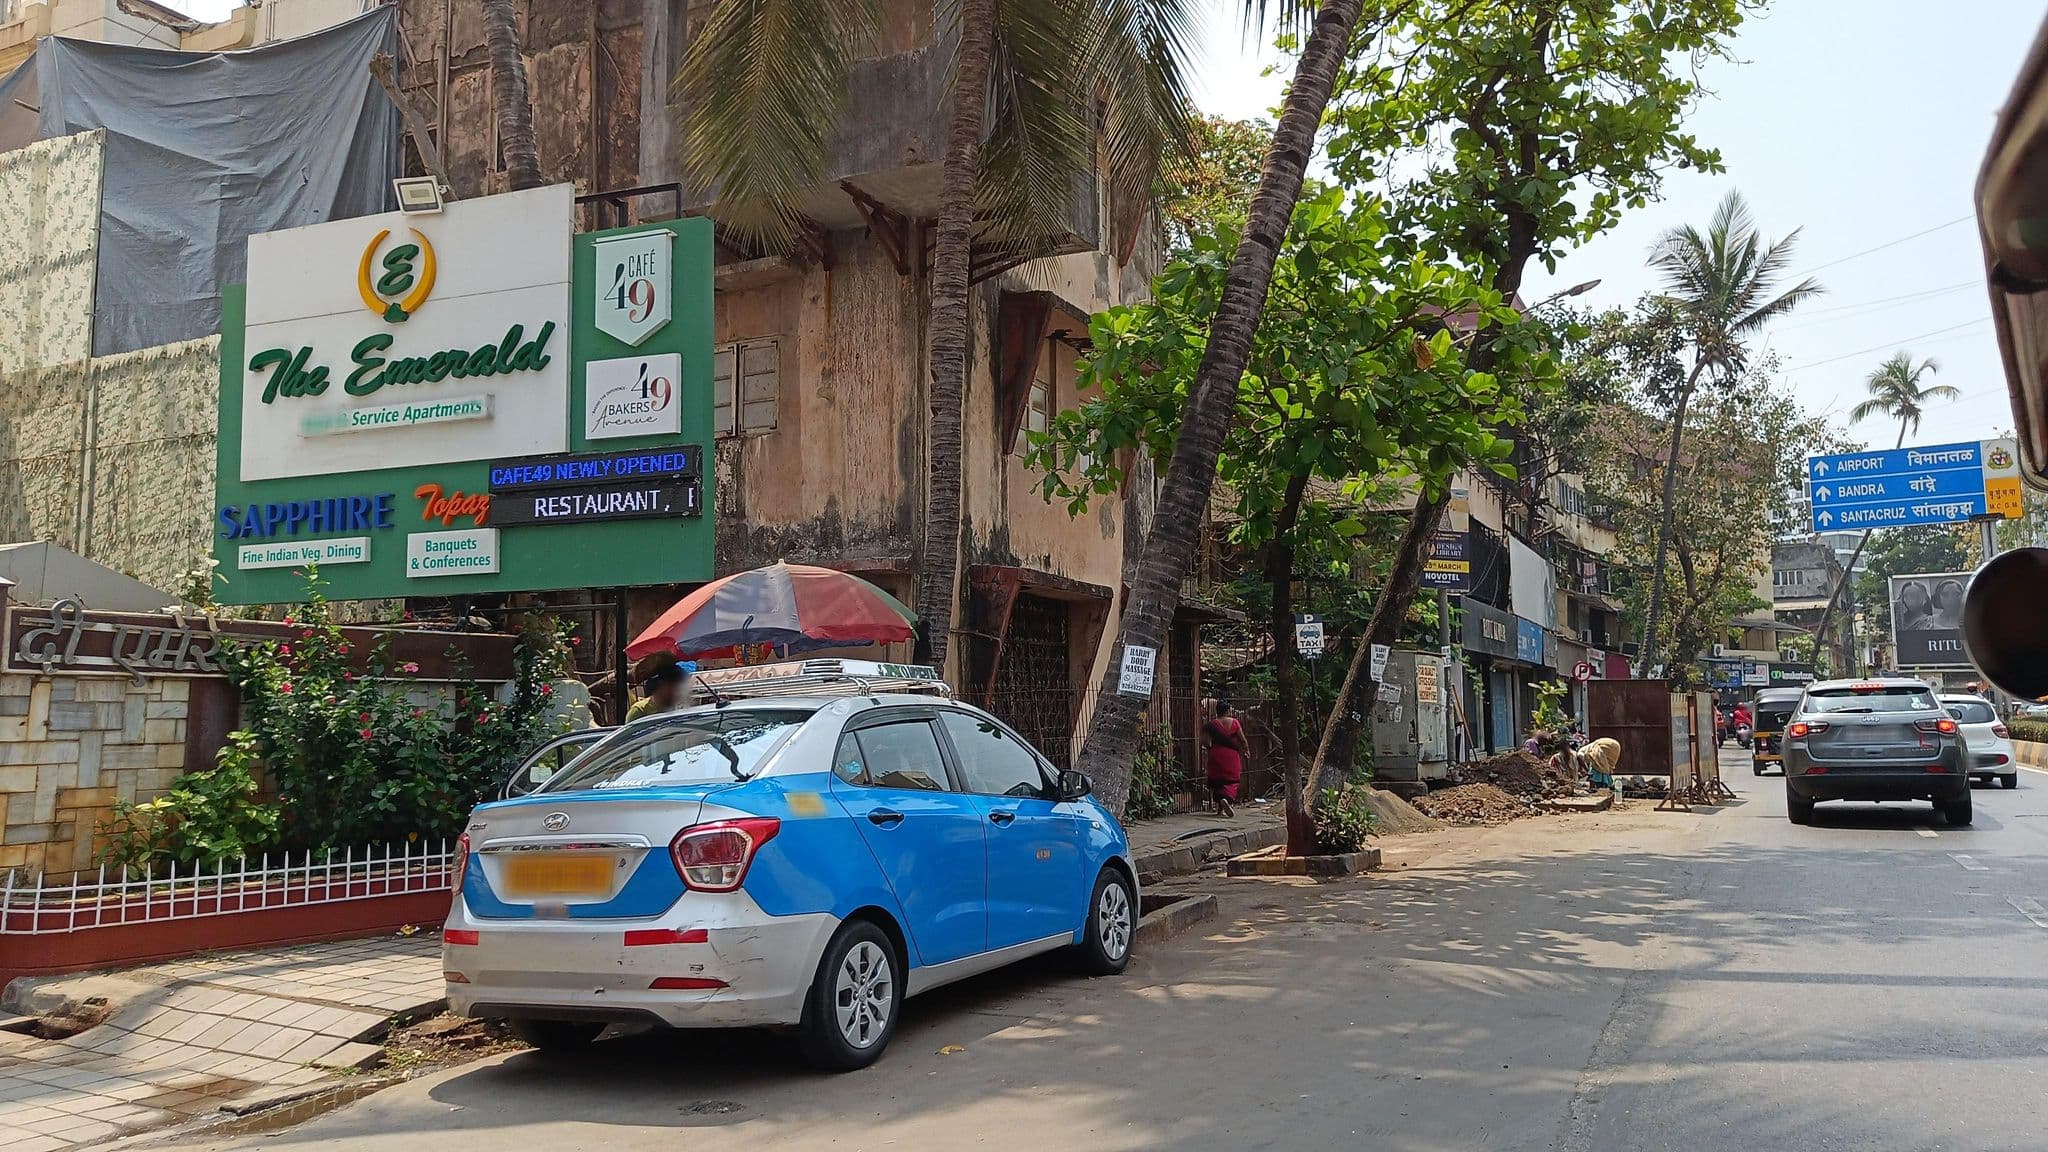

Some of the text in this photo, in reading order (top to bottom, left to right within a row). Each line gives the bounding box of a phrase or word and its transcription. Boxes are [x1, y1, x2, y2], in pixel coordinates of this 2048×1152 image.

[376, 243, 420, 297] E
[628, 249, 656, 278] CAFÉ
[603, 262, 656, 324] 49
[248, 320, 556, 405] The Emerald
[630, 362, 672, 412] 49
[351, 407, 399, 426] Service
[402, 400, 482, 424] Apartments
[608, 401, 650, 416] BAKERS
[591, 404, 658, 434] Avenue
[1837, 457, 1884, 473] AIRPORT
[1906, 448, 1975, 467] विमानतळ
[491, 453, 686, 486] CAFE49 NEWLY OPENED
[1838, 482, 1885, 498] BANDRA
[414, 482, 491, 528] Topaz
[219, 493, 396, 539] SAPPHIRE
[1840, 506, 1906, 523] SANTACRUZ
[242, 544, 362, 564] Fine Indian Veg. Dining
[425, 538, 477, 554] Banquets
[411, 553, 491, 570] & Conferences
[1438, 562, 1462, 570] MARCH
[1425, 573, 1460, 581] NOVOTEL
[1303, 614, 1314, 624] P
[1928, 639, 1963, 652] RITU
[1125, 664, 1151, 676] MASSAGE
[1130, 657, 1148, 667] BODY
